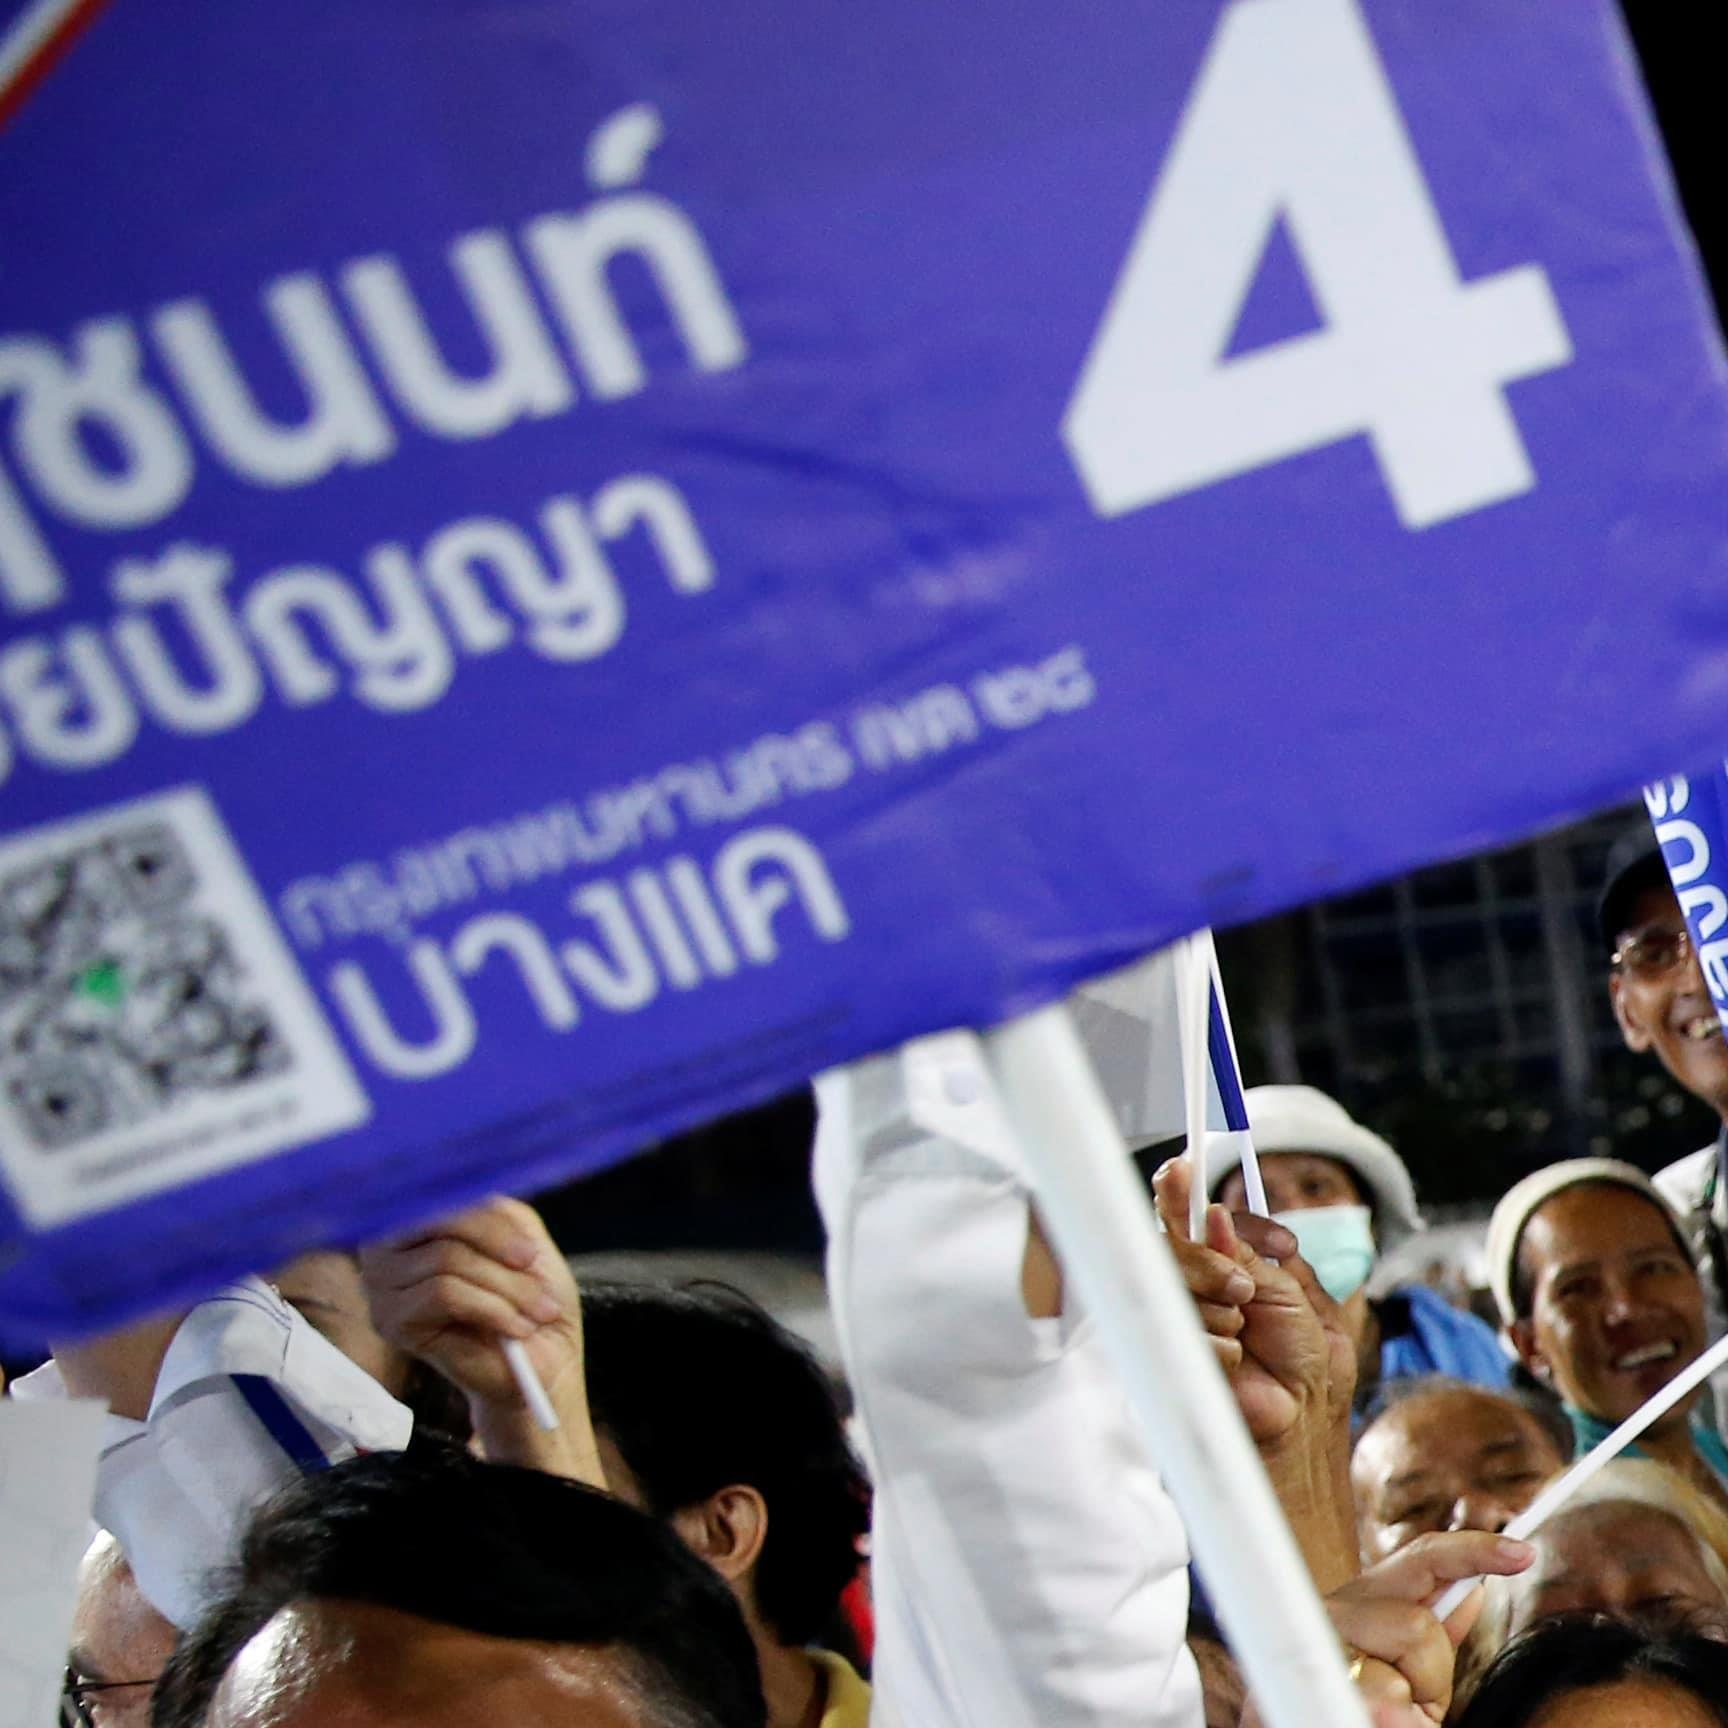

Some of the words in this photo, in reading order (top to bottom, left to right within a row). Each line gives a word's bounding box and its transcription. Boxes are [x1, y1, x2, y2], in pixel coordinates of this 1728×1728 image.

[1060, 0, 1574, 531] 4
[0, 473, 716, 782] ยปัญญา
[328, 823, 851, 1081] บางแค
